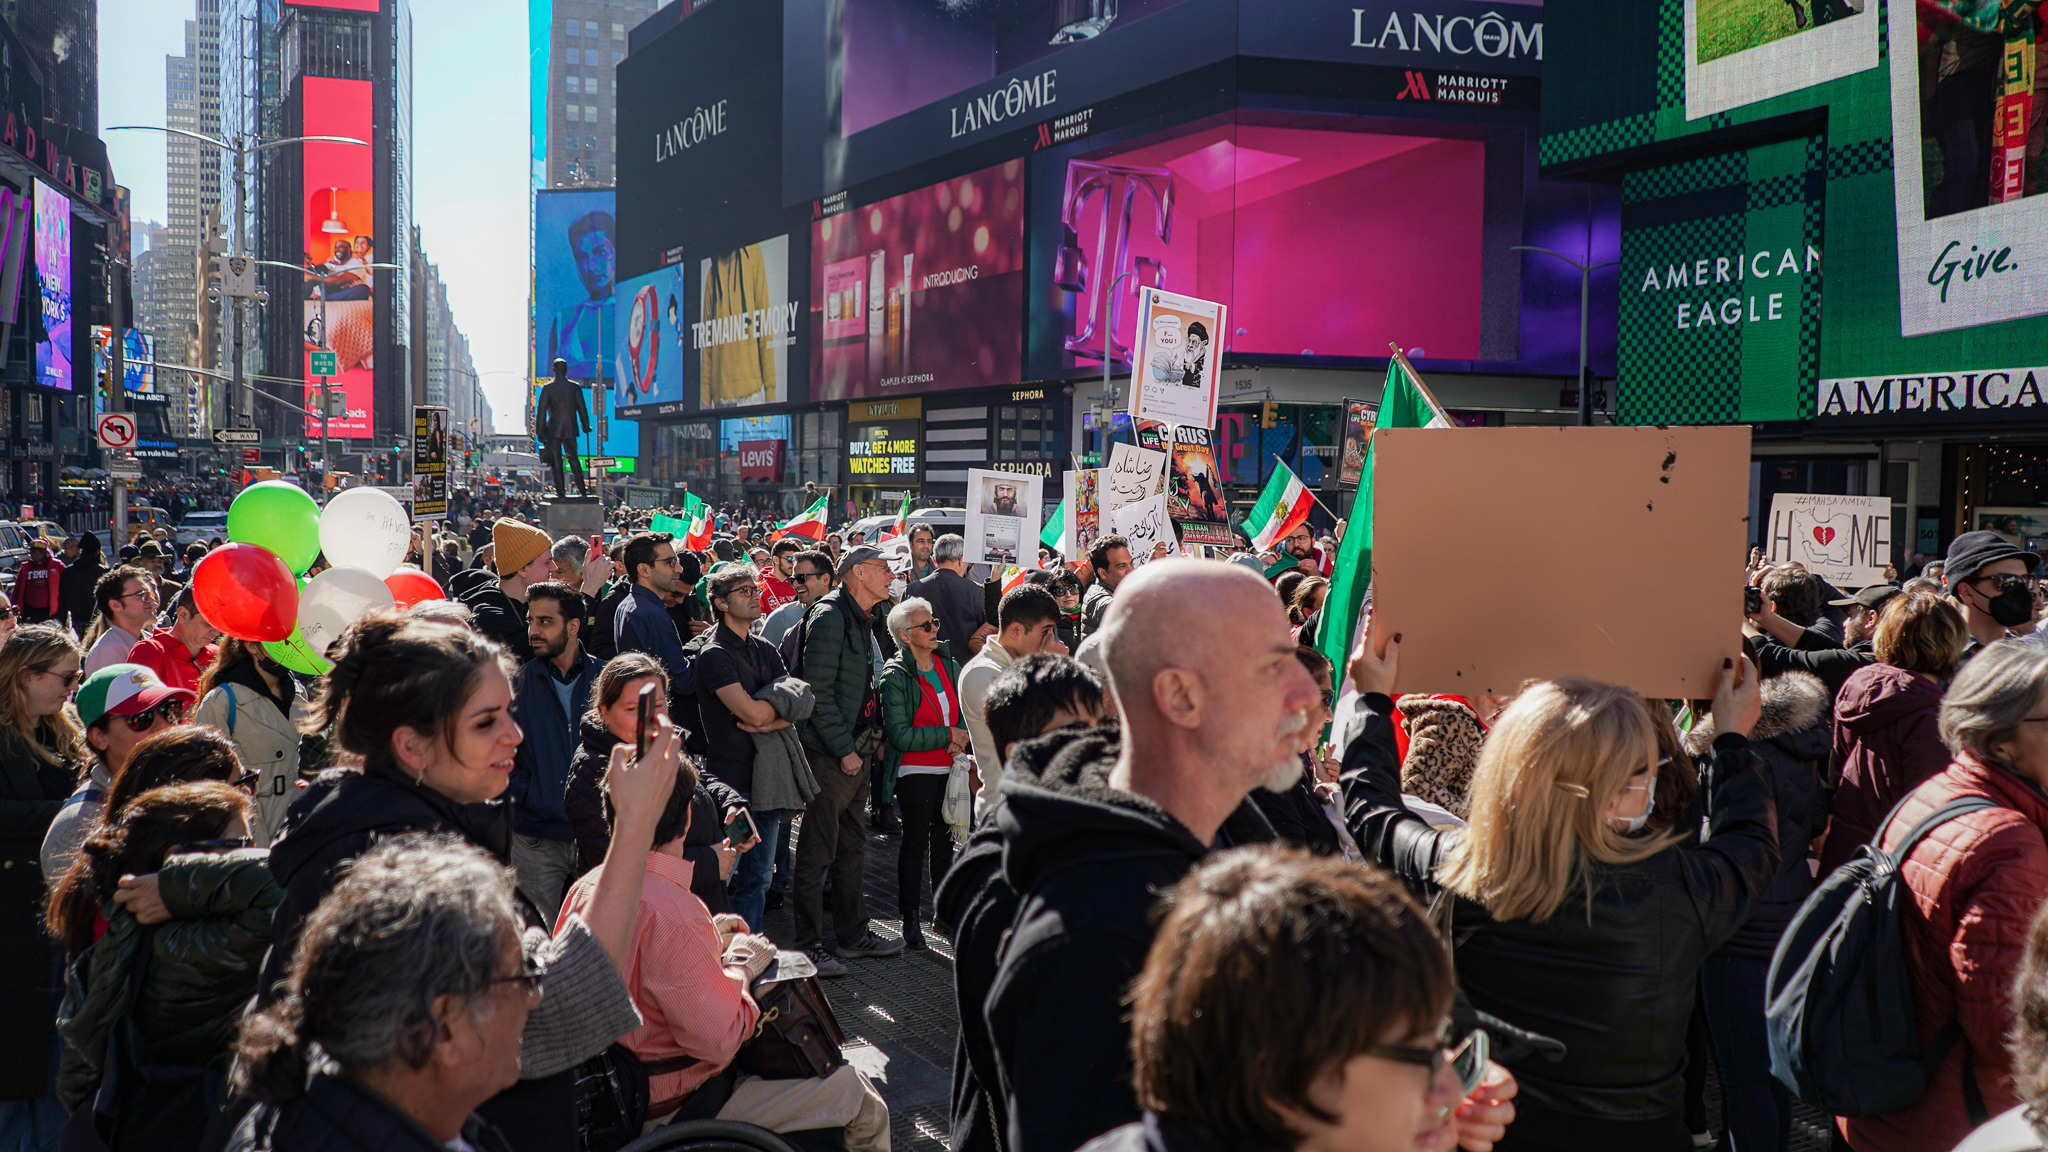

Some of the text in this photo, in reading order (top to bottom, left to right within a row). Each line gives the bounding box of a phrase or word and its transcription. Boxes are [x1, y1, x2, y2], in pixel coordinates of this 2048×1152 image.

[1438, 74, 1508, 90] MARRIOTT
[950, 69, 1057, 138] LANCÔME
[1437, 88, 1499, 104] MARQUIS
[1054, 108, 1094, 130] MARRIOTT
[655, 99, 727, 163] LANCÔME
[1054, 122, 1088, 142] MARQUIS
[823, 190, 847, 206] MARRIOTT
[823, 202, 845, 216] MARQUIS
[923, 265, 979, 289] INTRODUCING
[1927, 240, 2019, 304] Give.
[1677, 292, 1783, 330] EAGLE
[691, 300, 799, 350] TREMAINE EMORY
[880, 377, 900, 387] OLAPLEX
[907, 373, 934, 384] SEPHORA
[1234, 379, 1253, 390] 1535
[1012, 389, 1044, 401] SEPHORA
[1822, 370, 2048, 416] AMERICA
[868, 402, 899, 417] INVICTA
[849, 439, 916, 457] BUY 2, GET 4 MORE
[1142, 436, 1160, 446] LIFE
[1174, 442, 1194, 452] Great
[1195, 444, 1210, 454] Day
[849, 456, 915, 474] WATCHES FREE
[1194, 523, 1209, 532] IRAN
